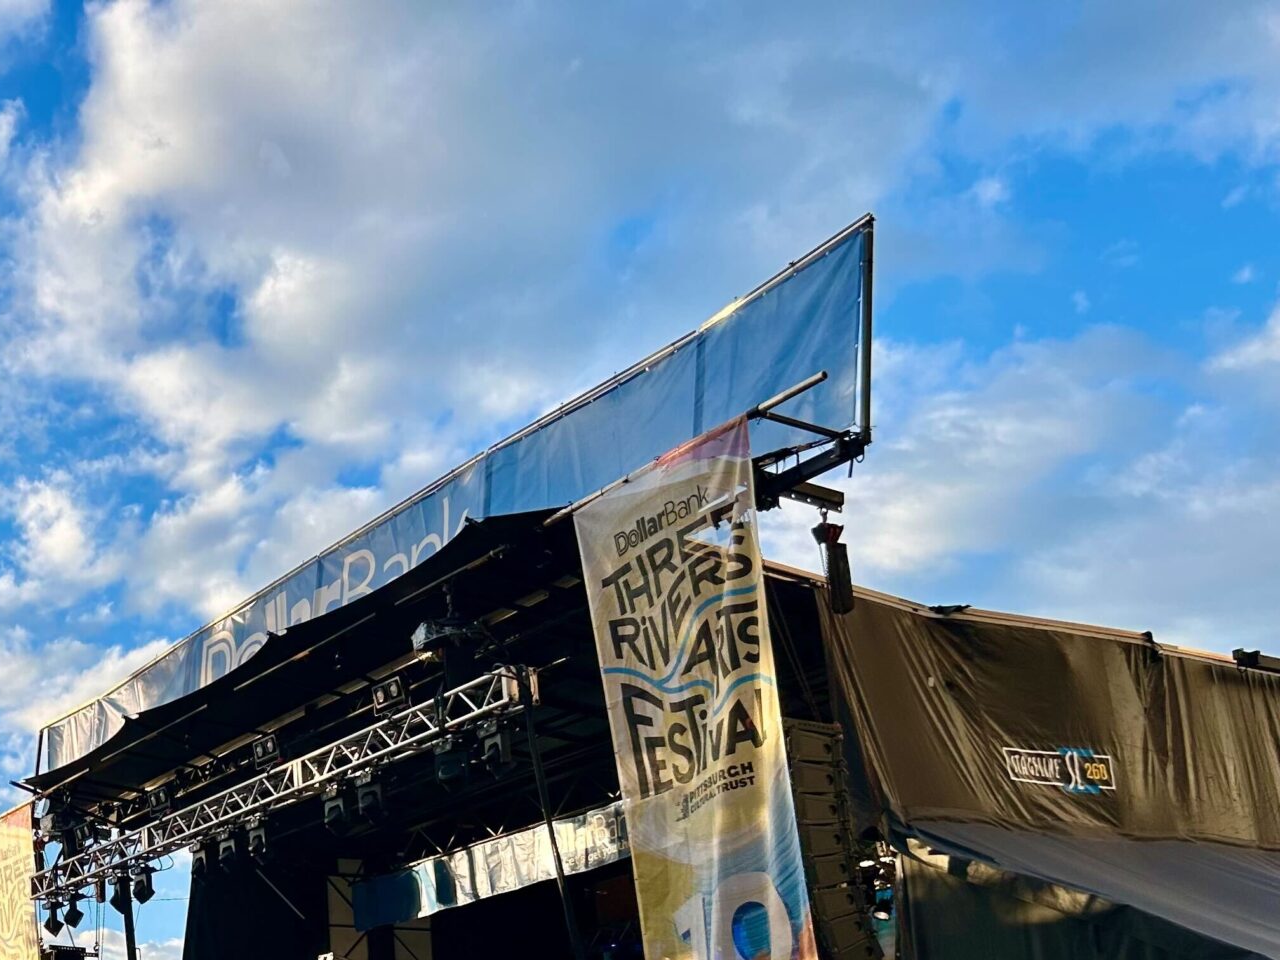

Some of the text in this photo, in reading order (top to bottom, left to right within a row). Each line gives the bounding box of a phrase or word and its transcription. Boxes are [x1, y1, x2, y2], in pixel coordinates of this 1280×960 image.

[613, 484, 710, 556] DollarBank
[601, 498, 745, 616] THREE
[717, 775, 756, 793] TRUST
[1010, 754, 1060, 779] STAGELINE
[1084, 763, 1108, 781] 260
